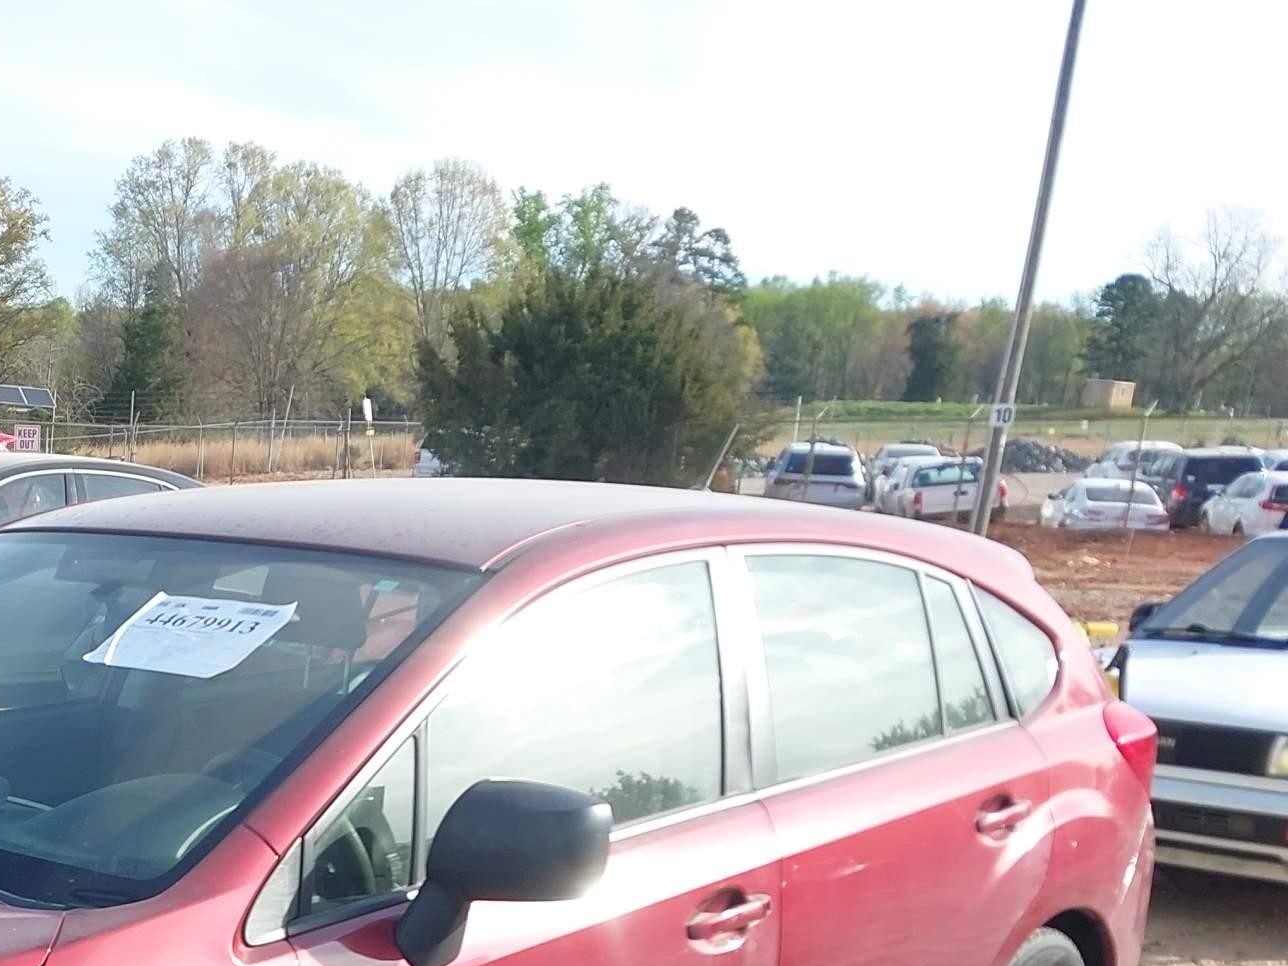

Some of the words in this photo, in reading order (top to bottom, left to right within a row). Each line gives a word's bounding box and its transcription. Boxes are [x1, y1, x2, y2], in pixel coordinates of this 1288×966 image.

[996, 407, 1012, 423] 10
[17, 428, 37, 438] KEEP
[19, 439, 35, 449] OUT
[146, 612, 261, 634] 44679913
